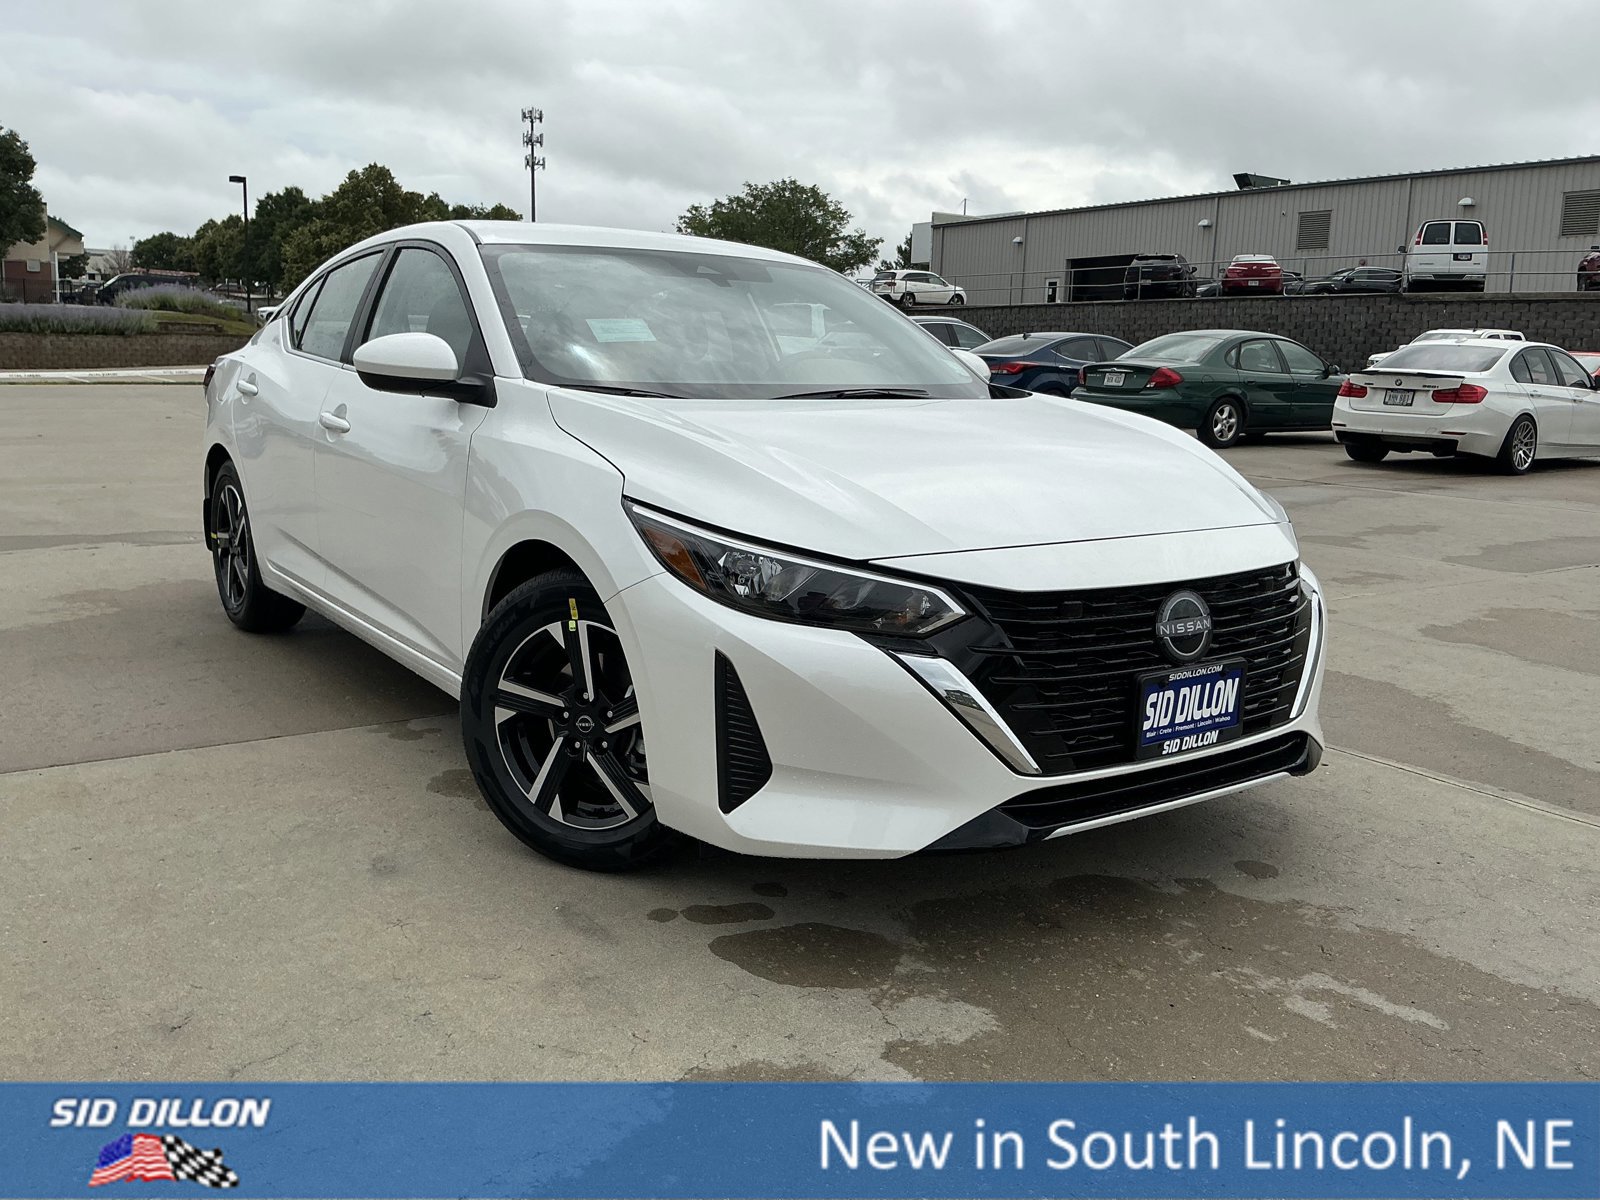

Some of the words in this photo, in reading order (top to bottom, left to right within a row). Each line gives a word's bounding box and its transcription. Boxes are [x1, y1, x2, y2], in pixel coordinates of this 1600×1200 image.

[1160, 618, 1210, 635] NISSAN
[1169, 665, 1223, 681] SIDDILLON.COM
[1143, 690, 1175, 731] SID
[1175, 678, 1239, 724] DILLON
[1175, 723, 1195, 732] Fremont
[1197, 719, 1212, 727] Lincoln
[1162, 738, 1181, 755] SID
[1181, 730, 1219, 751] DILLON
